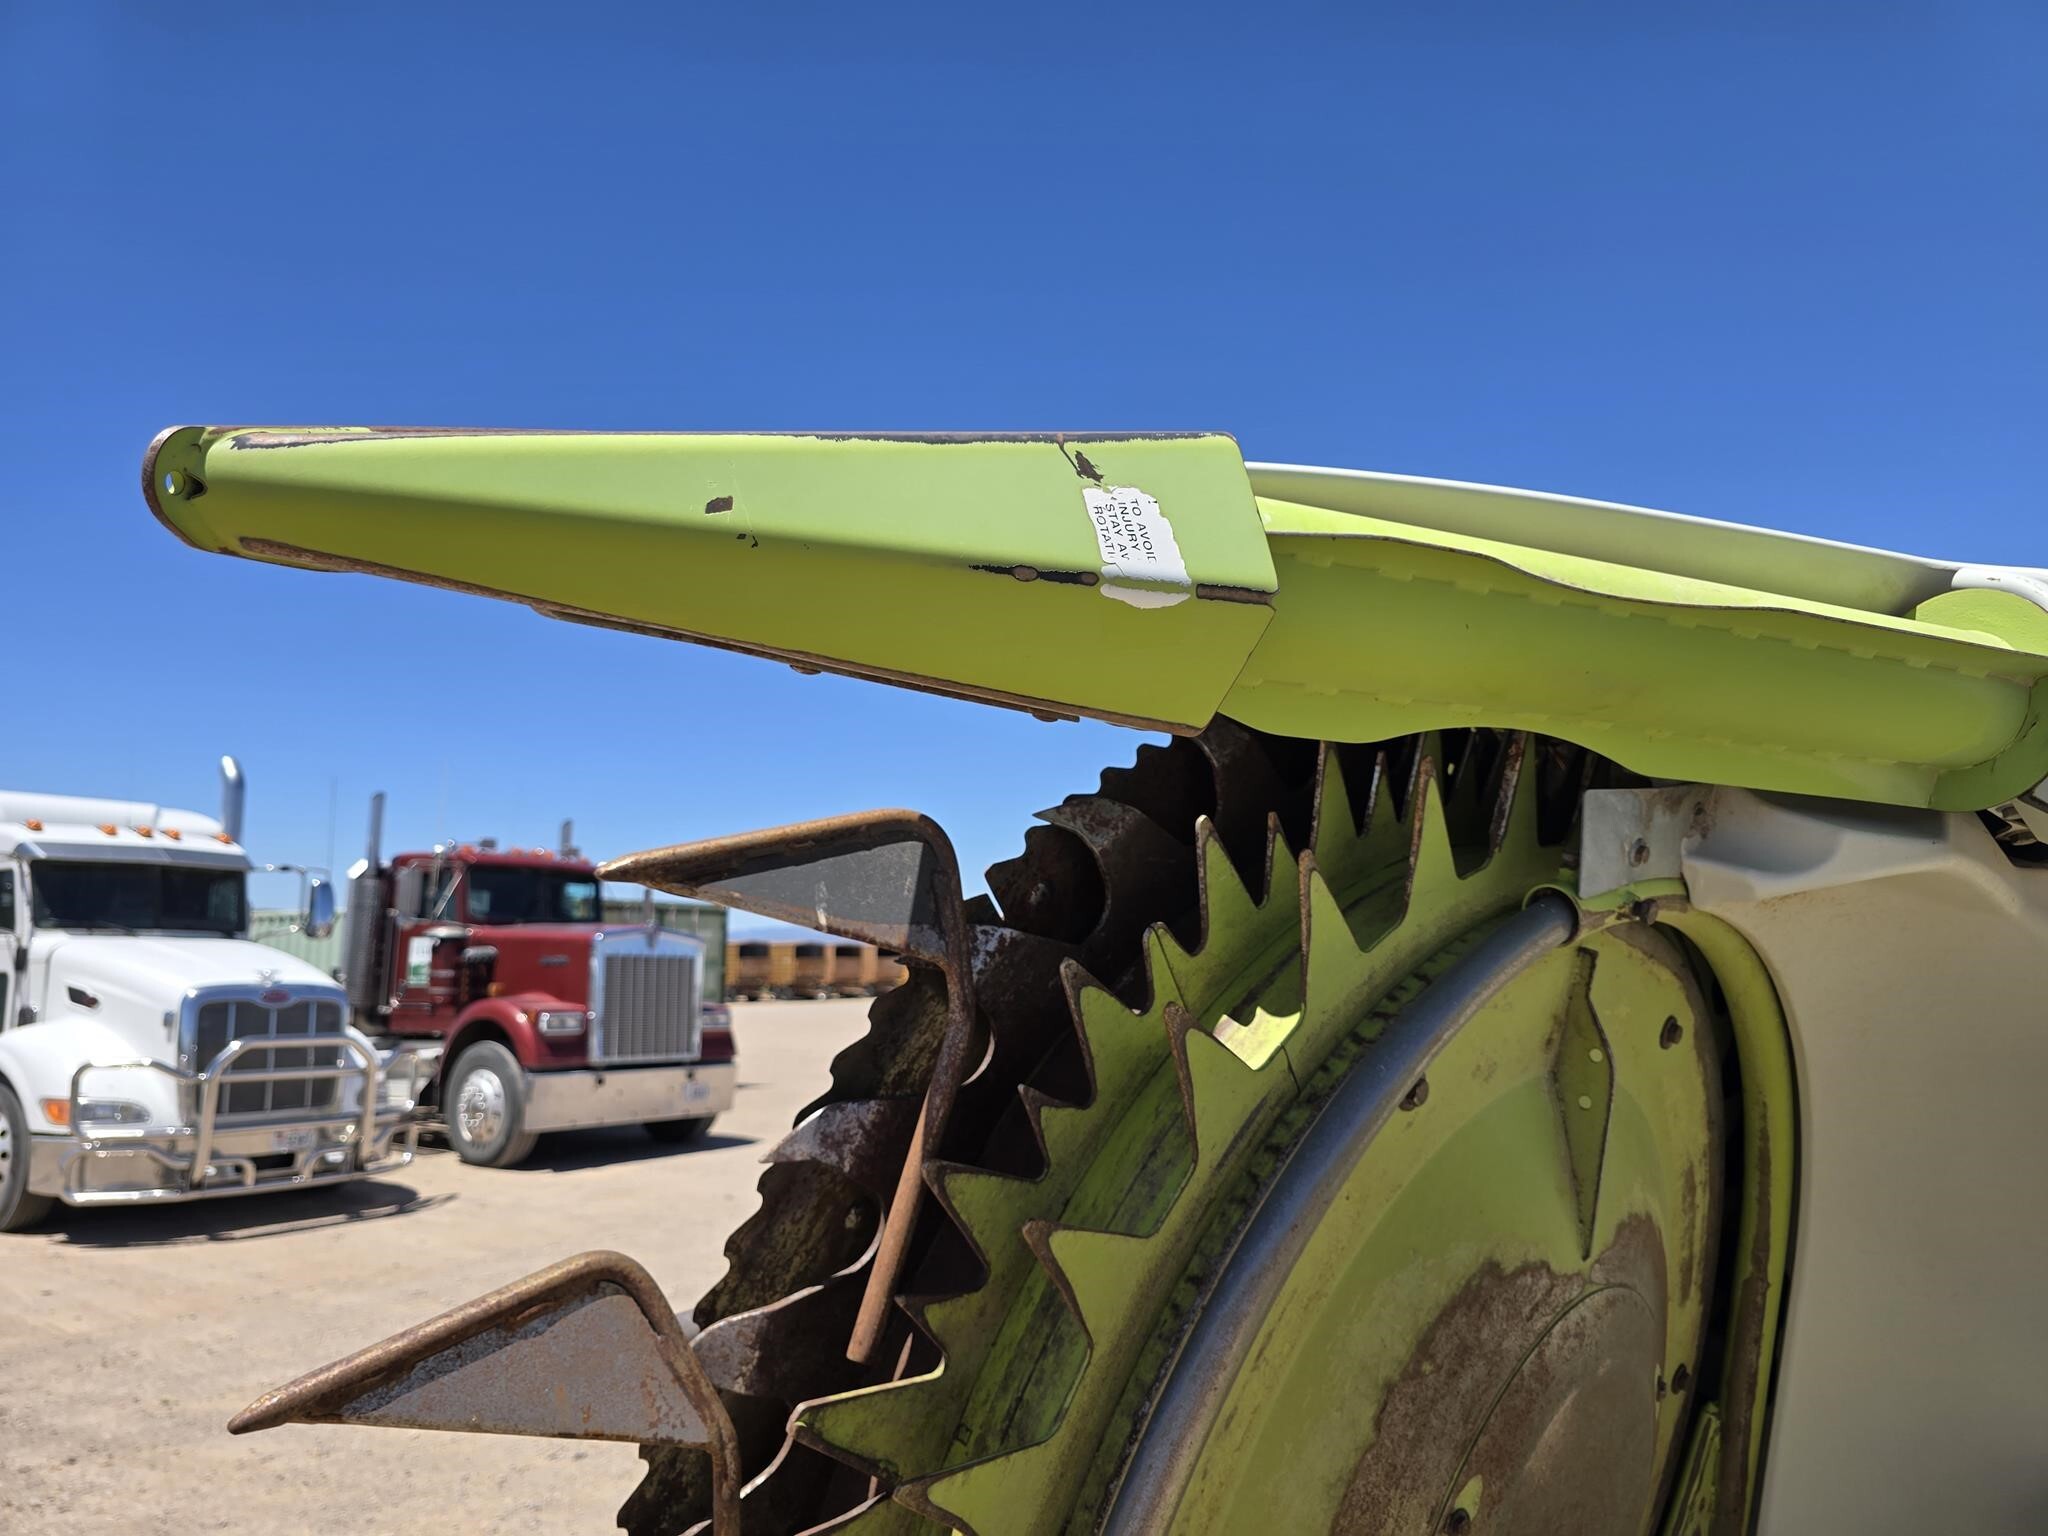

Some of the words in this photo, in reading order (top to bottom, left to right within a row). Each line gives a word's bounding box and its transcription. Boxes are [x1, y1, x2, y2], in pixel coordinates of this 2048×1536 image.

[1105, 503, 1123, 537] STAY
[1118, 502, 1141, 551] INJURY
[1130, 498, 1142, 516] TO
[1093, 505, 1116, 558] ROTATI
